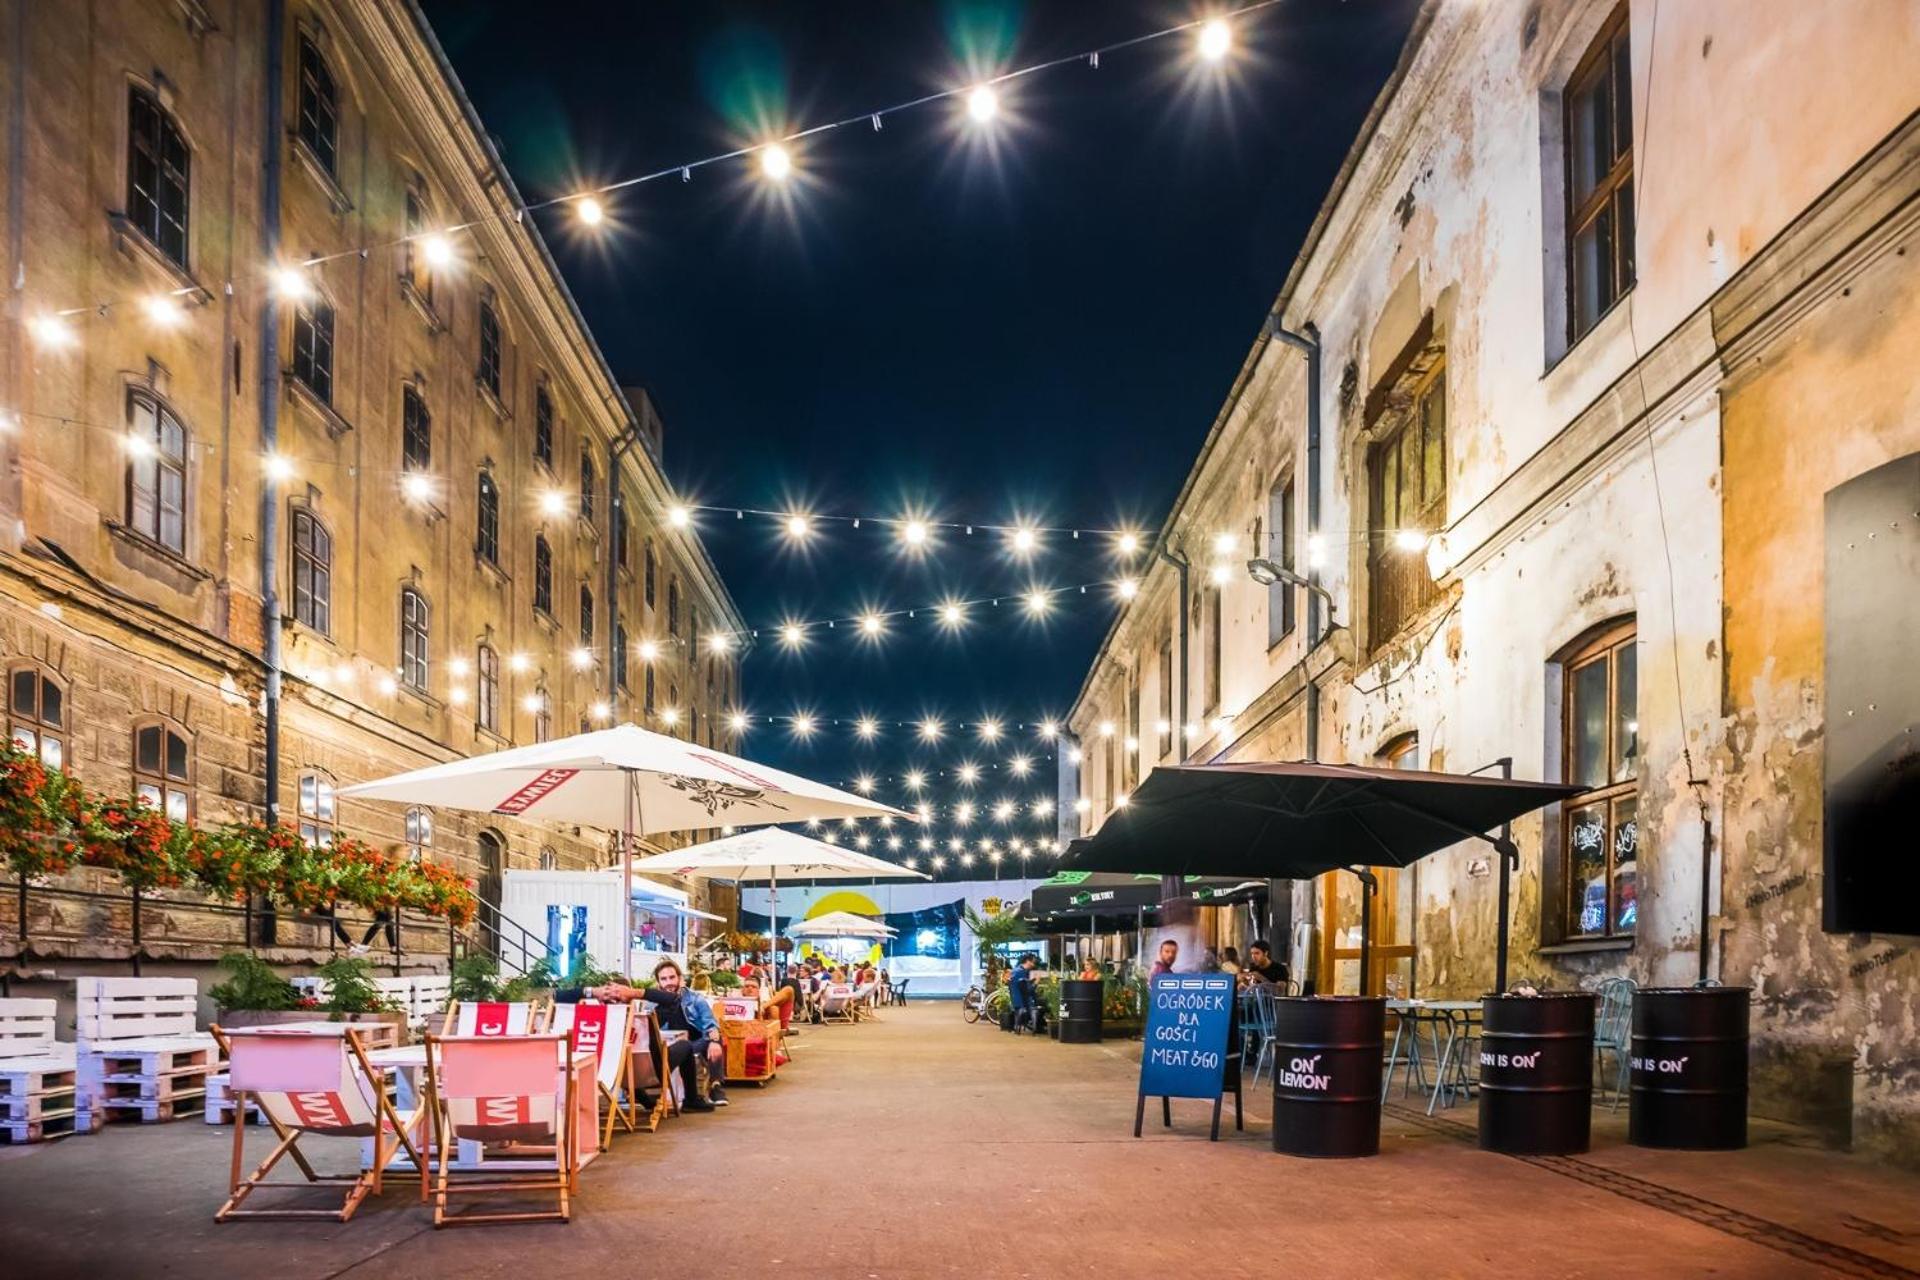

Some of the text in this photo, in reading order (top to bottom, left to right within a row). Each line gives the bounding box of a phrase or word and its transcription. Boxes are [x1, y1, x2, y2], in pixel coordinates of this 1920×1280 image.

[1157, 993, 1224, 1010] OGRÓDEK
[1178, 1012, 1200, 1026] DLA
[1151, 1047, 1190, 1066] MEAT
[1497, 1053, 1508, 1068] IS
[1511, 1055, 1535, 1068] ON
[1290, 1057, 1315, 1073] ON
[1645, 1058, 1655, 1072] IS
[1658, 1059, 1682, 1073] ON
[1279, 1068, 1329, 1091] LEMON
